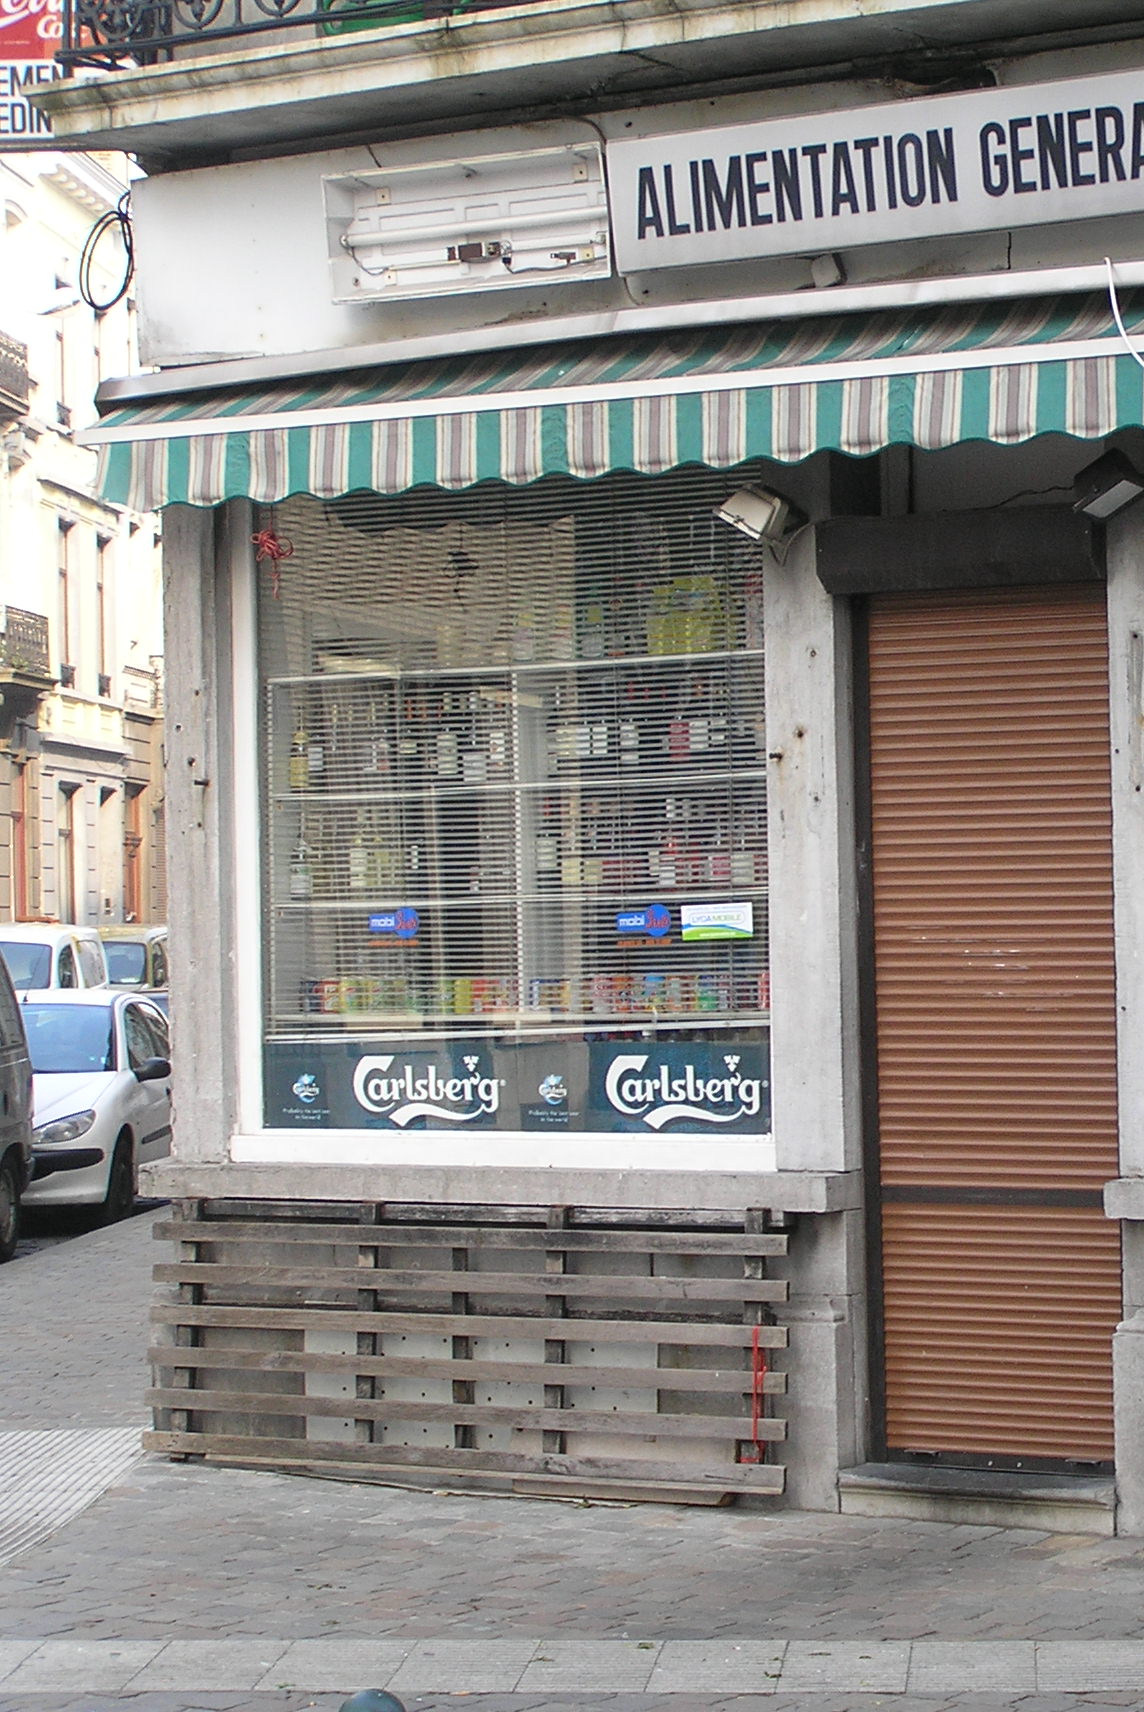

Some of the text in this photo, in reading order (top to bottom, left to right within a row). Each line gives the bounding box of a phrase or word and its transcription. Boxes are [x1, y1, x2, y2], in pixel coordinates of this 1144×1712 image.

[637, 128, 958, 240] ALIMENTATION
[353, 1053, 501, 1127] Carlsberg
[605, 1055, 762, 1130] Carlsberg
